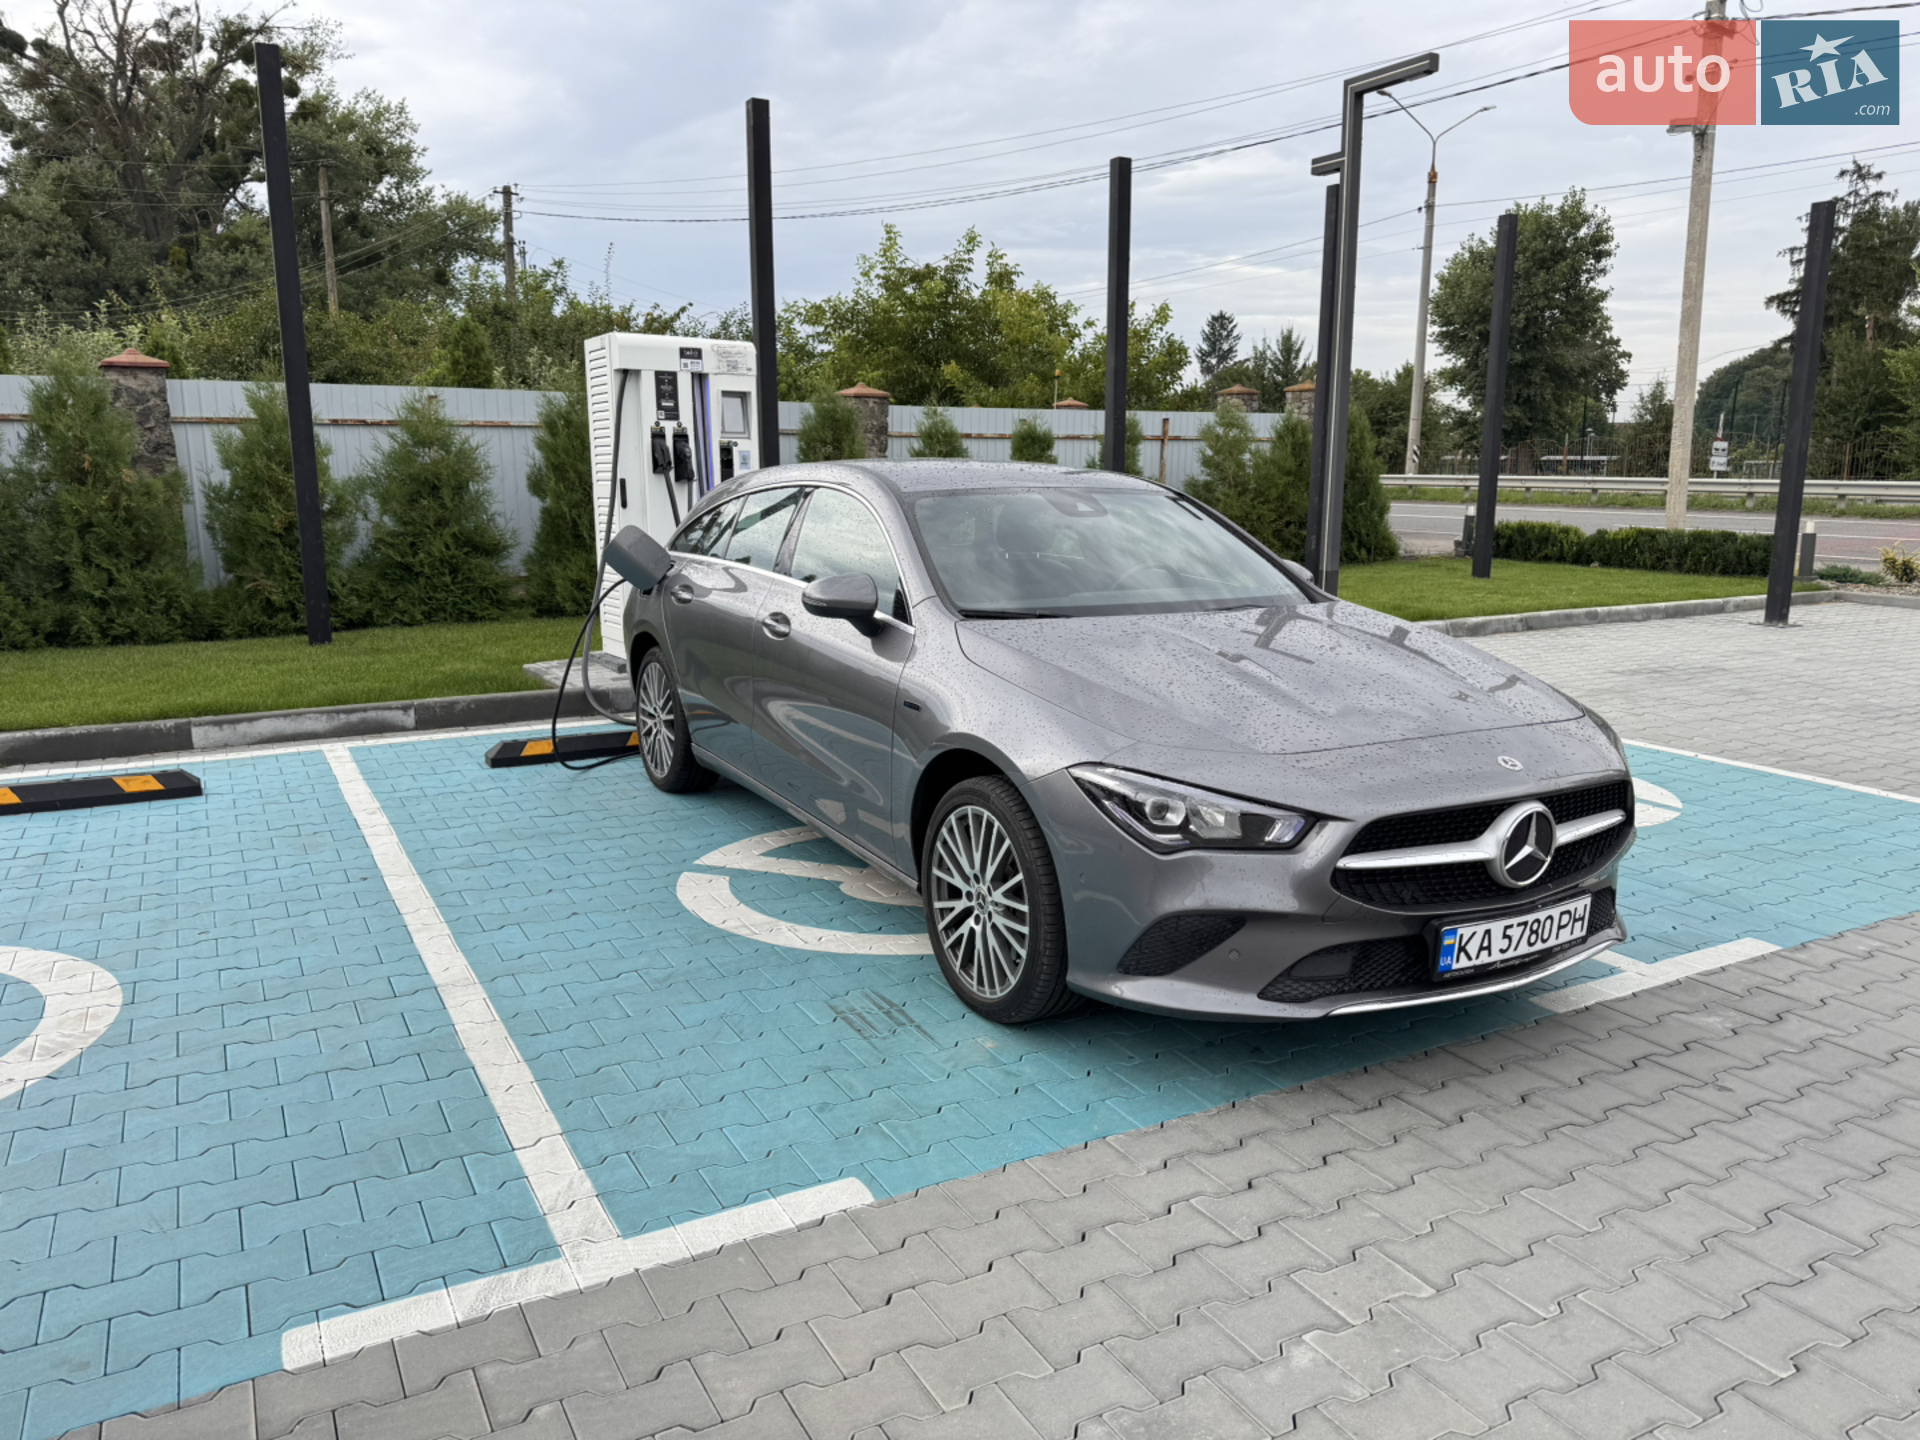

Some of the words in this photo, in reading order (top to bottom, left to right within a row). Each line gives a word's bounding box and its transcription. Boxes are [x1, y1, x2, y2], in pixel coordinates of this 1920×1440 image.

[1455, 929, 1492, 964] KA
[1499, 915, 1554, 954] 5780
[1555, 903, 1588, 940] PH
[1440, 957, 1452, 966] UA
